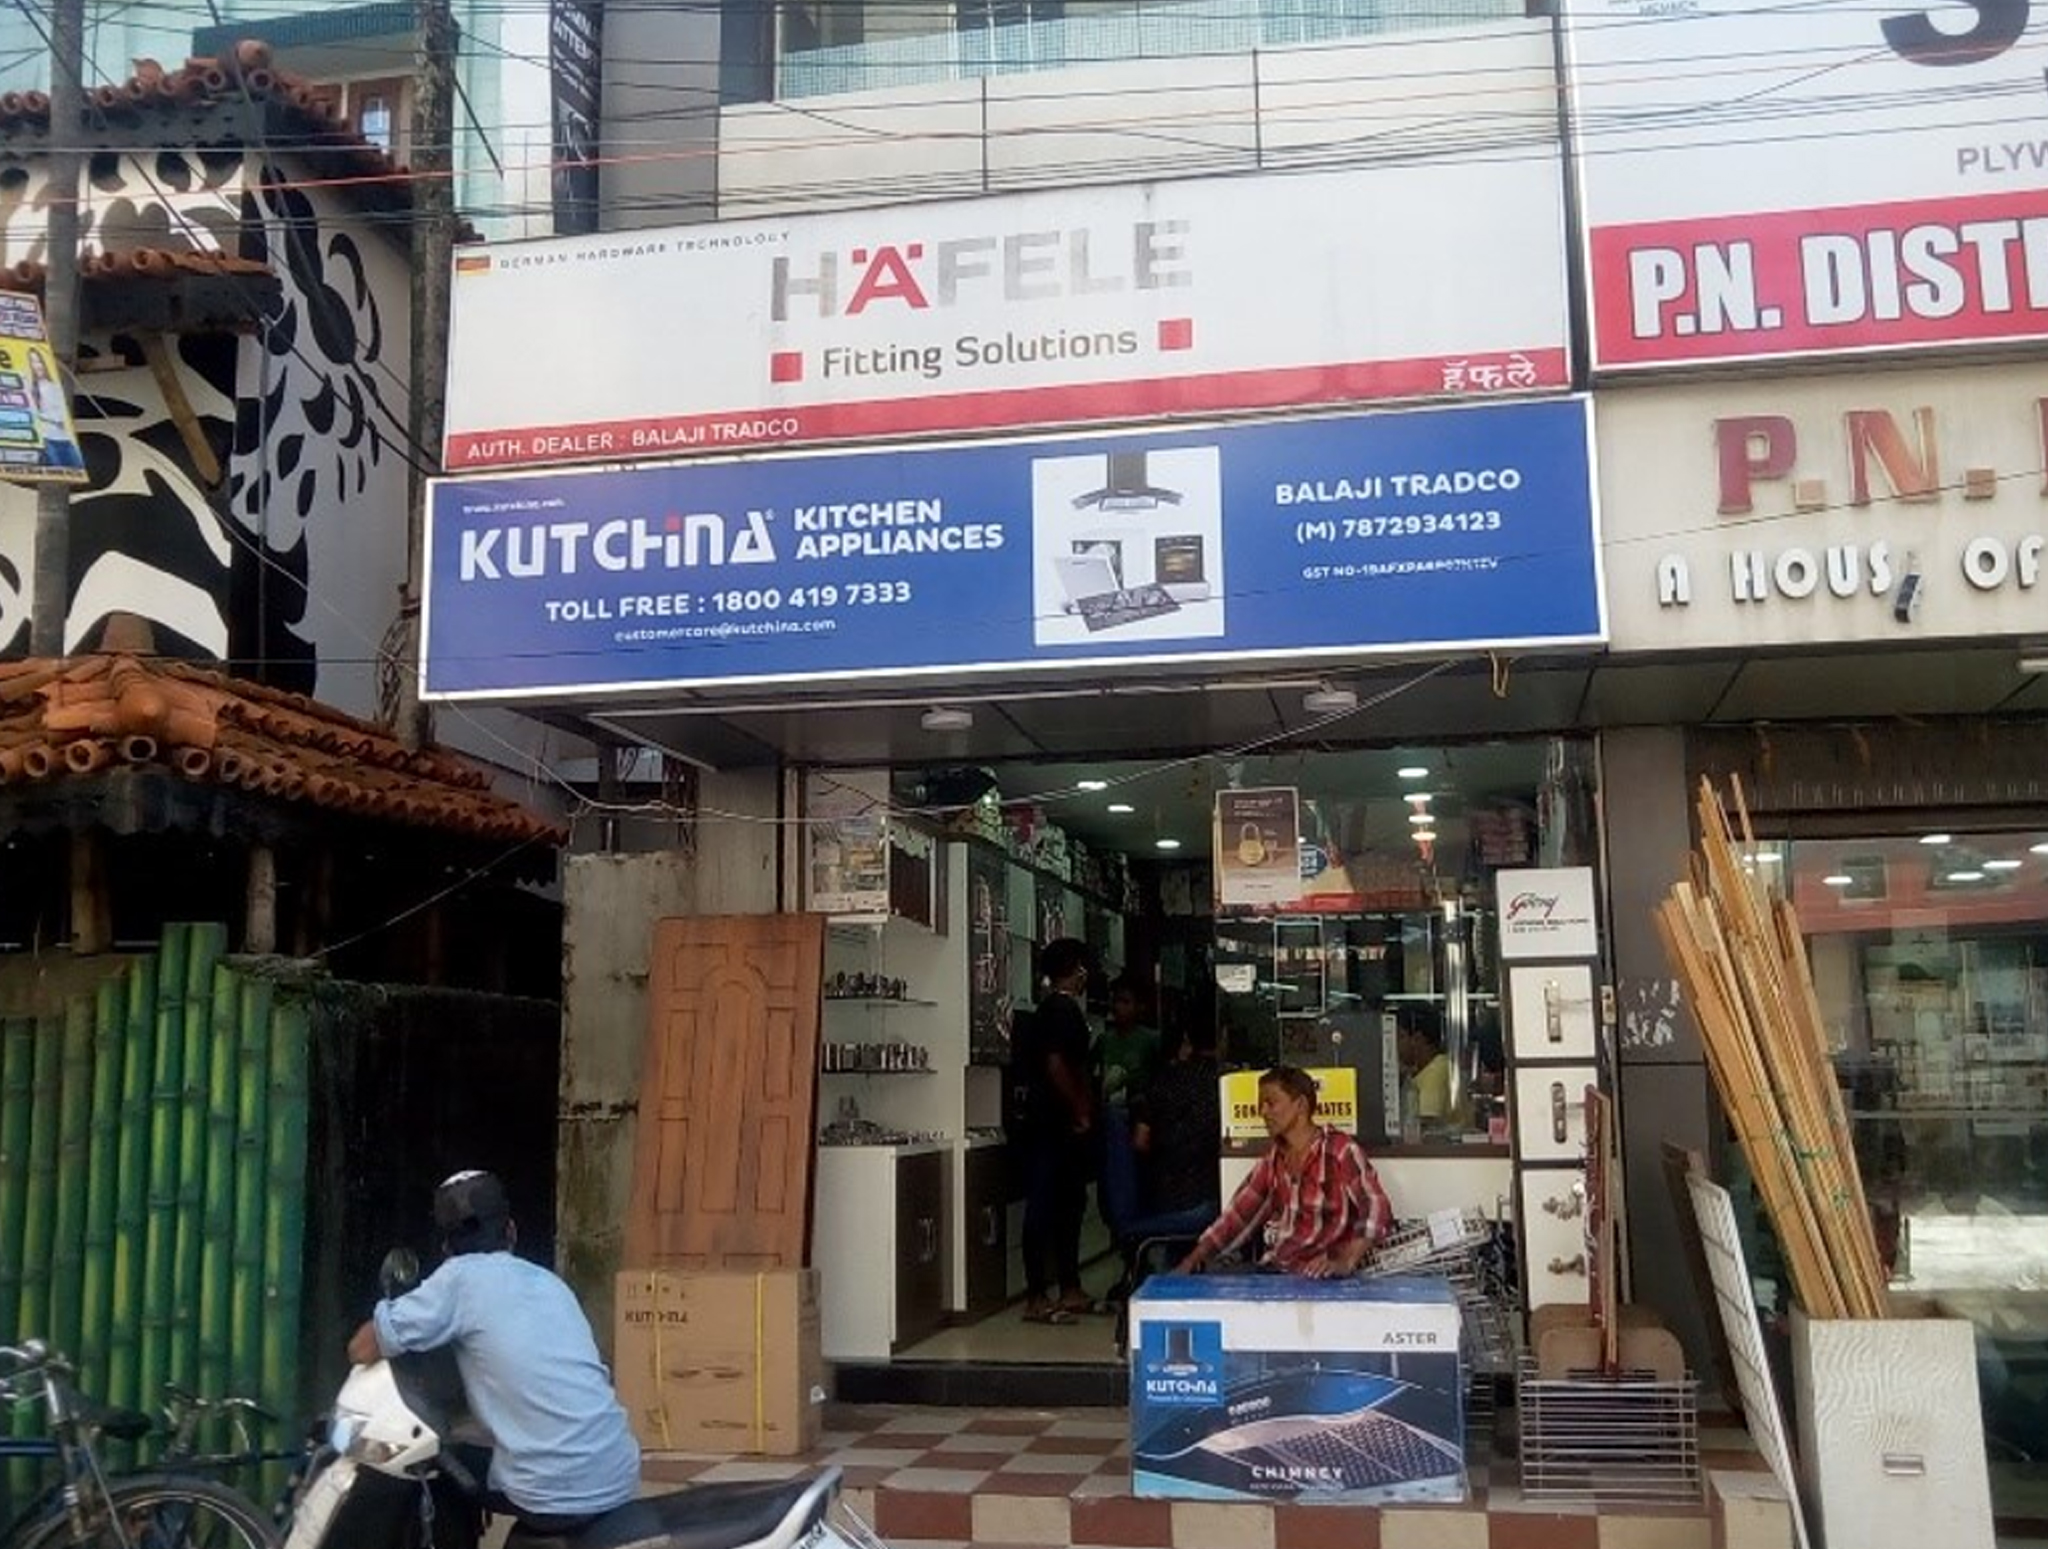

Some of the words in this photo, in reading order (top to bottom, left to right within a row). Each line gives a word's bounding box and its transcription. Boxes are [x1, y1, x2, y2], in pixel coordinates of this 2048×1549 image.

[576, 242, 667, 261] HARDWARE
[676, 230, 791, 251] TECHNOLOGY
[770, 220, 1193, 322] HÄFELE
[1628, 240, 1782, 338] P.N.
[823, 344, 942, 379] Fitting
[956, 330, 1138, 367] Solutions
[468, 439, 526, 460] AUTH.
[532, 433, 614, 454] DEALER
[632, 426, 706, 448] BALAJI
[710, 418, 799, 441] TRADCO
[1275, 476, 1383, 504] BALAJI
[1390, 468, 1522, 497] TRADCO
[794, 500, 943, 532] KITCHEN
[1296, 519, 1337, 544] (M)
[1342, 510, 1502, 539] 7872934123
[796, 523, 1004, 560] APPLIANCES
[1302, 566, 1332, 579] GST
[1658, 551, 1691, 608] A
[1962, 532, 2046, 592] OF
[545, 598, 613, 623] TOLL
[621, 592, 690, 617] FREE
[712, 586, 781, 613] 1800
[788, 583, 839, 609] 419
[845, 580, 912, 605] 7333
[1382, 1331, 1437, 1345] ASTER
[1251, 1465, 1342, 1480] CHIMNEY
